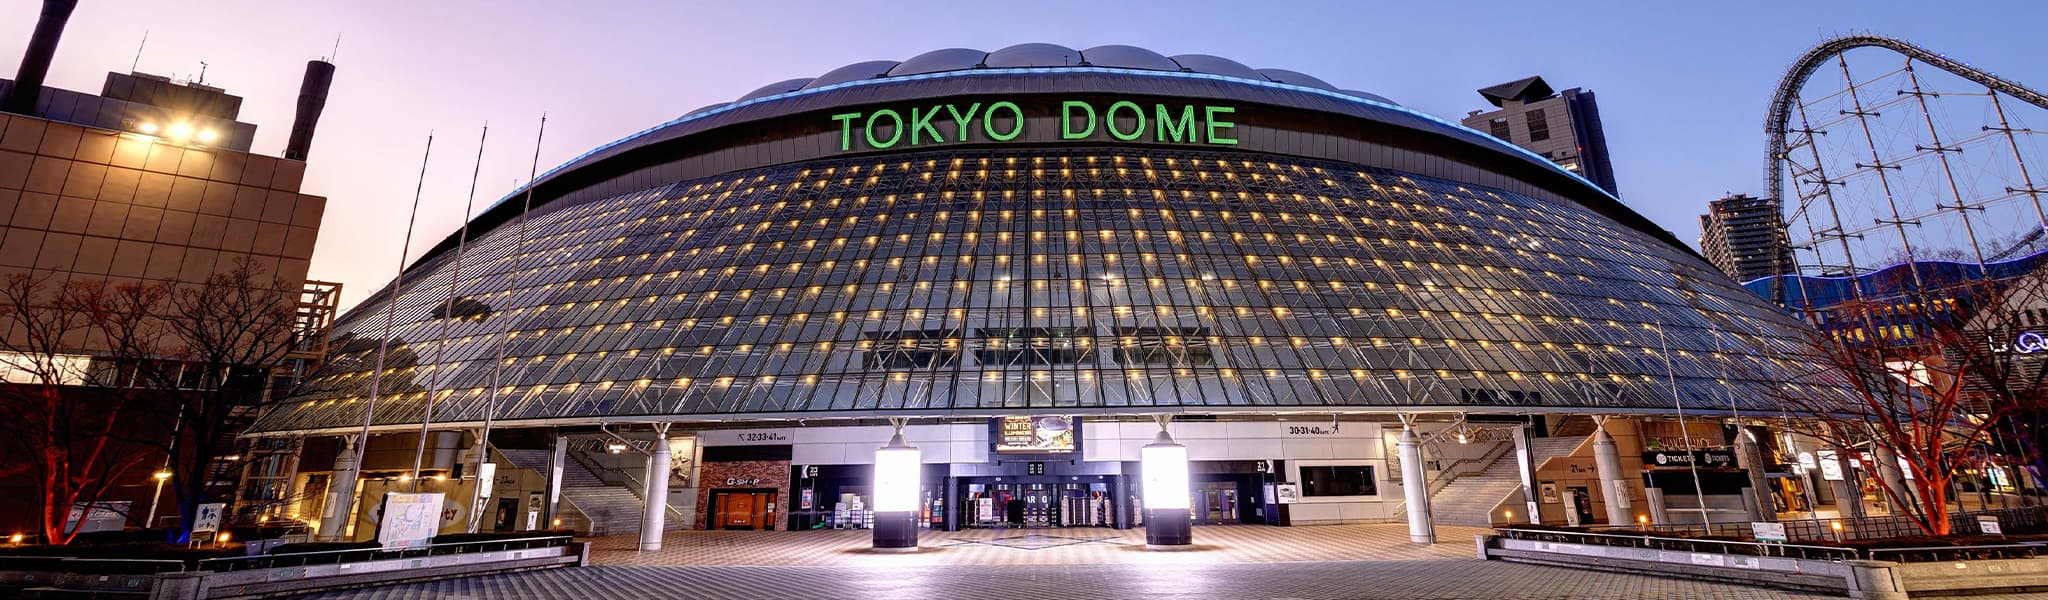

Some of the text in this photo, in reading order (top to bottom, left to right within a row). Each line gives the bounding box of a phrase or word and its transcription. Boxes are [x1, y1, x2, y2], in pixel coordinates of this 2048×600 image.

[832, 100, 1239, 151] TOKYO DOME
[1004, 422, 1032, 430] WINTER
